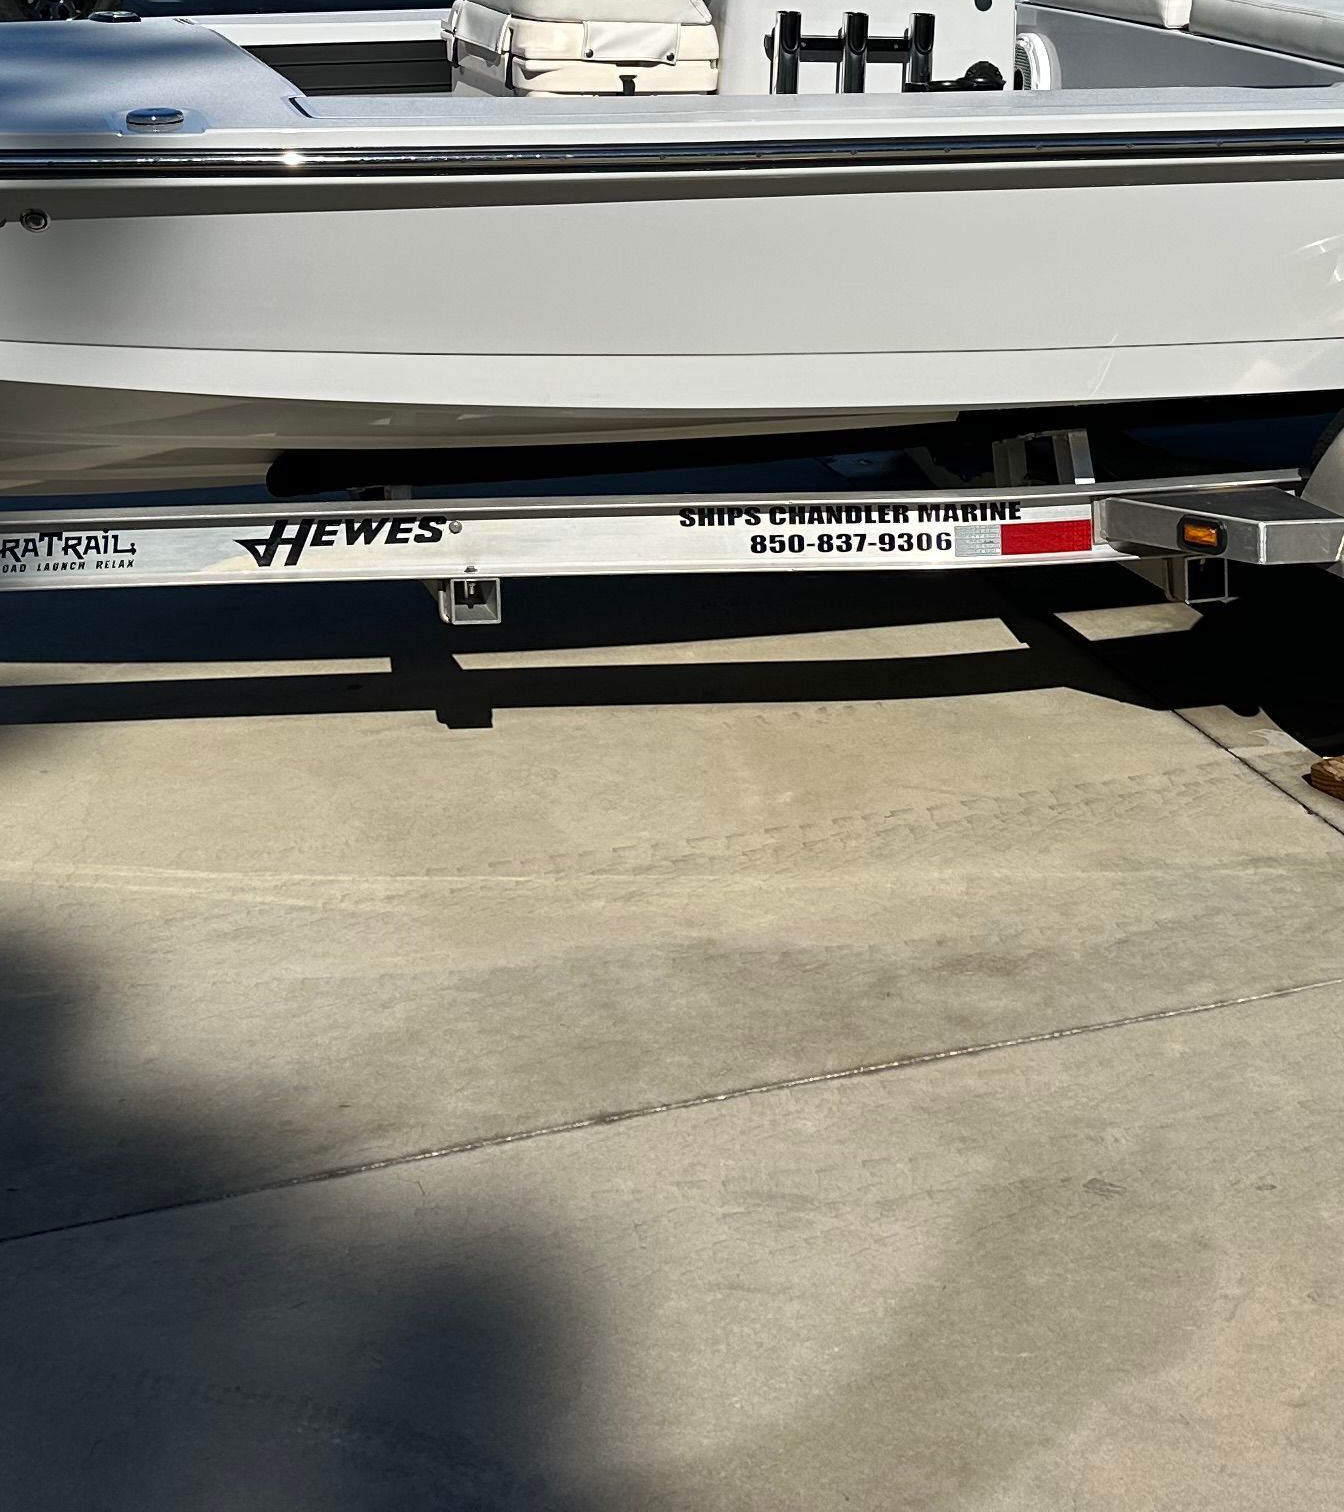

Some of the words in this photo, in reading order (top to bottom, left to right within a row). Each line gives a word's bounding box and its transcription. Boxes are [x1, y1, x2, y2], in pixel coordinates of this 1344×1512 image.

[679, 505, 762, 528] SHIPS
[769, 503, 910, 526] CHANDLER
[917, 500, 1023, 524] MARINE
[233, 515, 449, 567] HEWES
[750, 531, 953, 555] 850-837-9306
[36, 561, 86, 572] LAUNCH
[95, 559, 135, 570] RELAX
